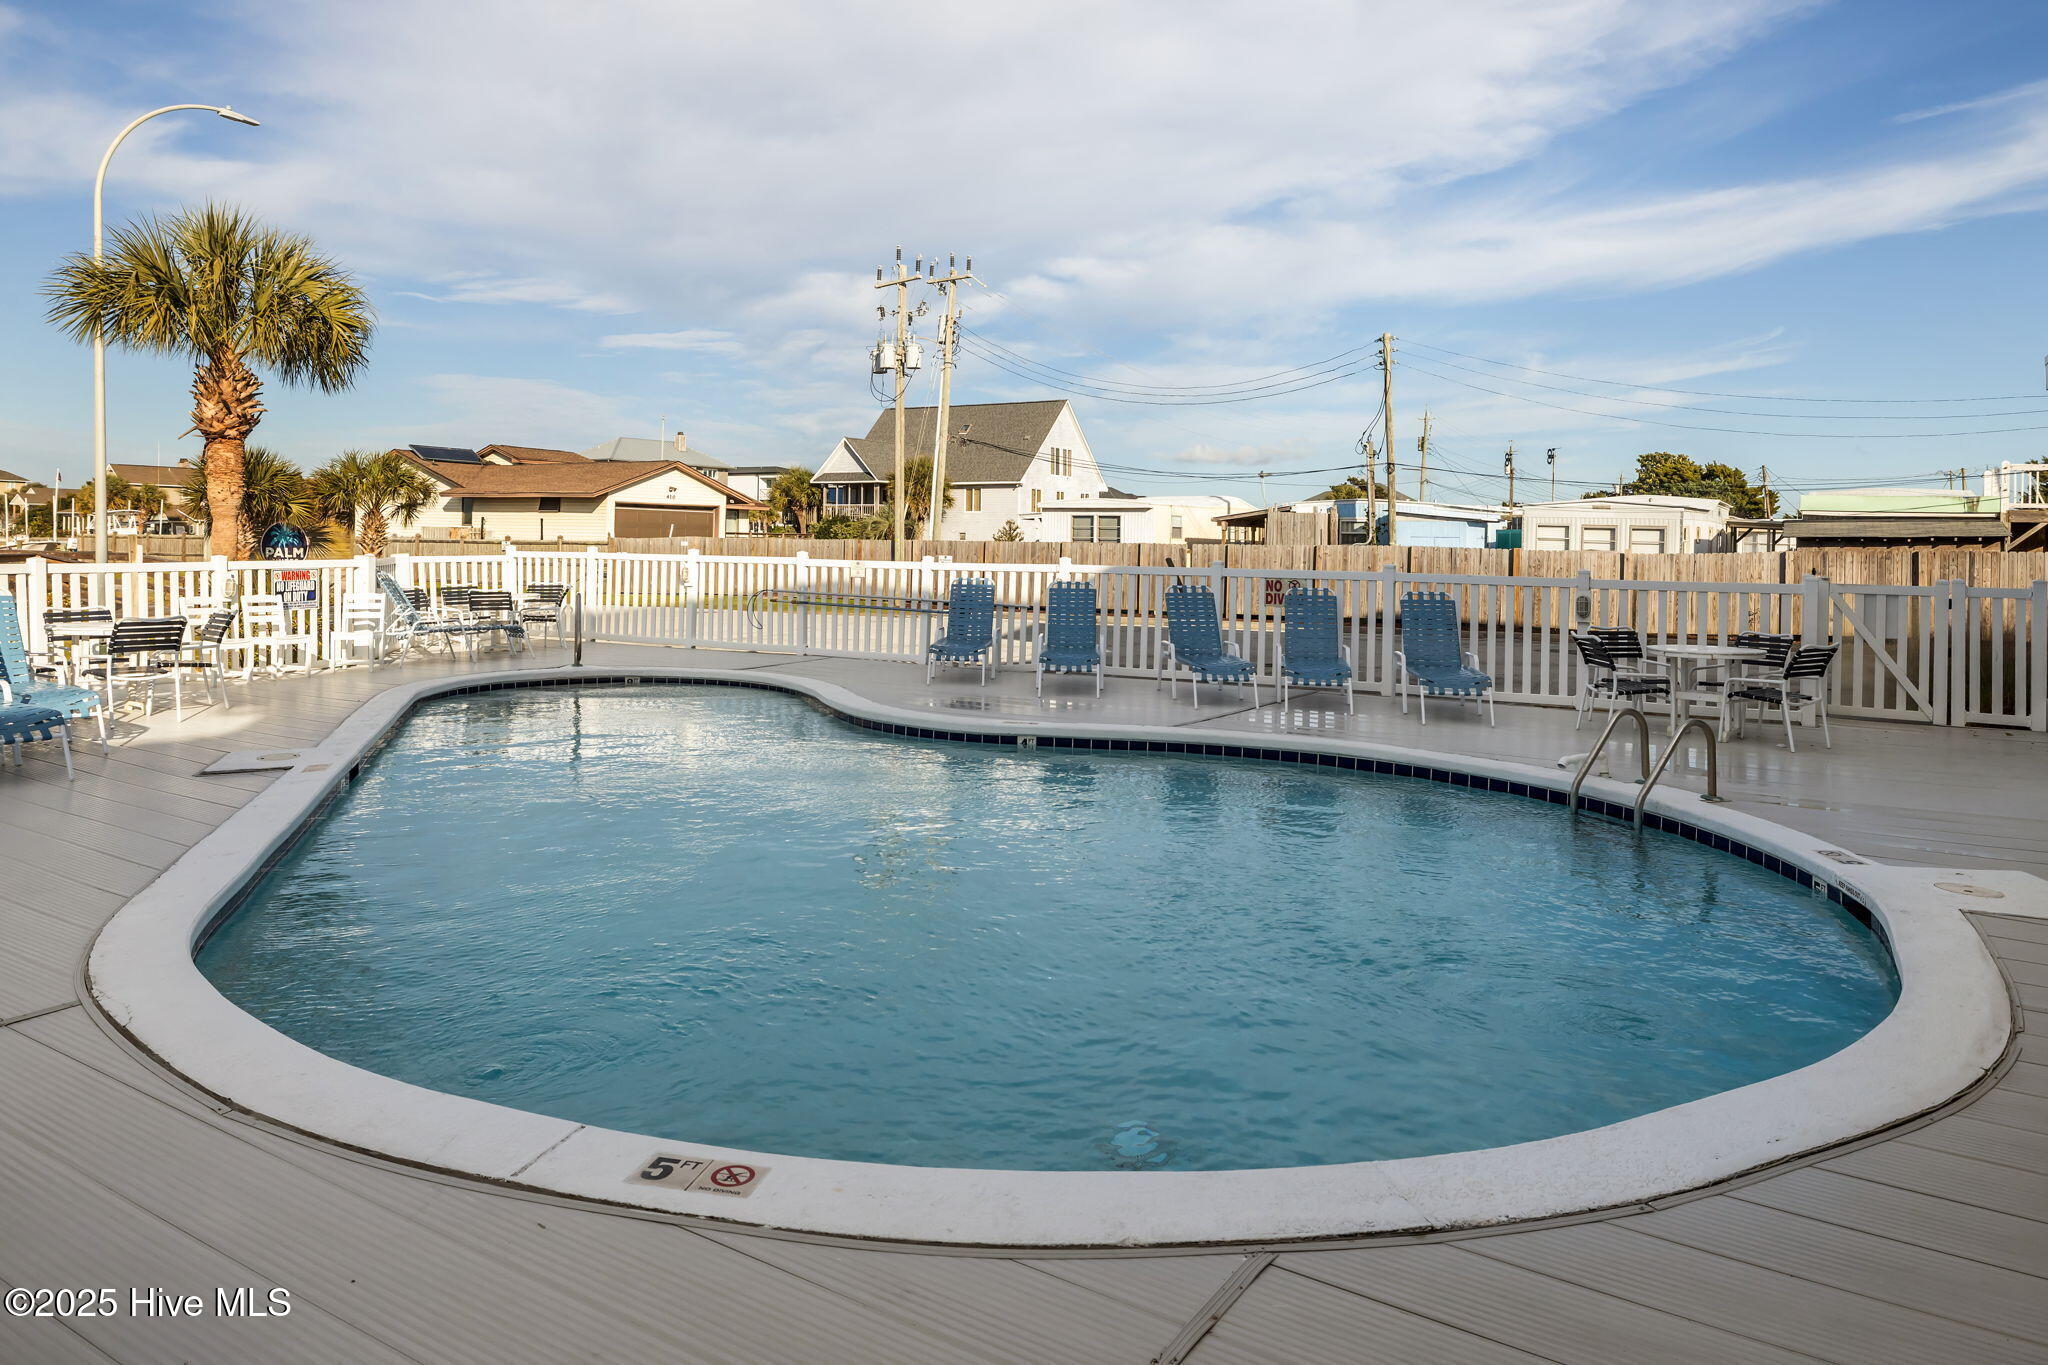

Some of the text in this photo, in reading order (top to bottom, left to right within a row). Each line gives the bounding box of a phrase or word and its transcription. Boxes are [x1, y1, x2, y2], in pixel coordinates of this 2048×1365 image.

[265, 547, 304, 558] PALM
[282, 570, 311, 580] WARNING
[277, 581, 315, 592] NO LIFEGUARD
[1265, 580, 1282, 592] NO
[283, 591, 308, 602] ON DUTY
[1265, 592, 1285, 605] DIV
[640, 1156, 703, 1180] 5 FT
[713, 1187, 741, 1195] DIVING
